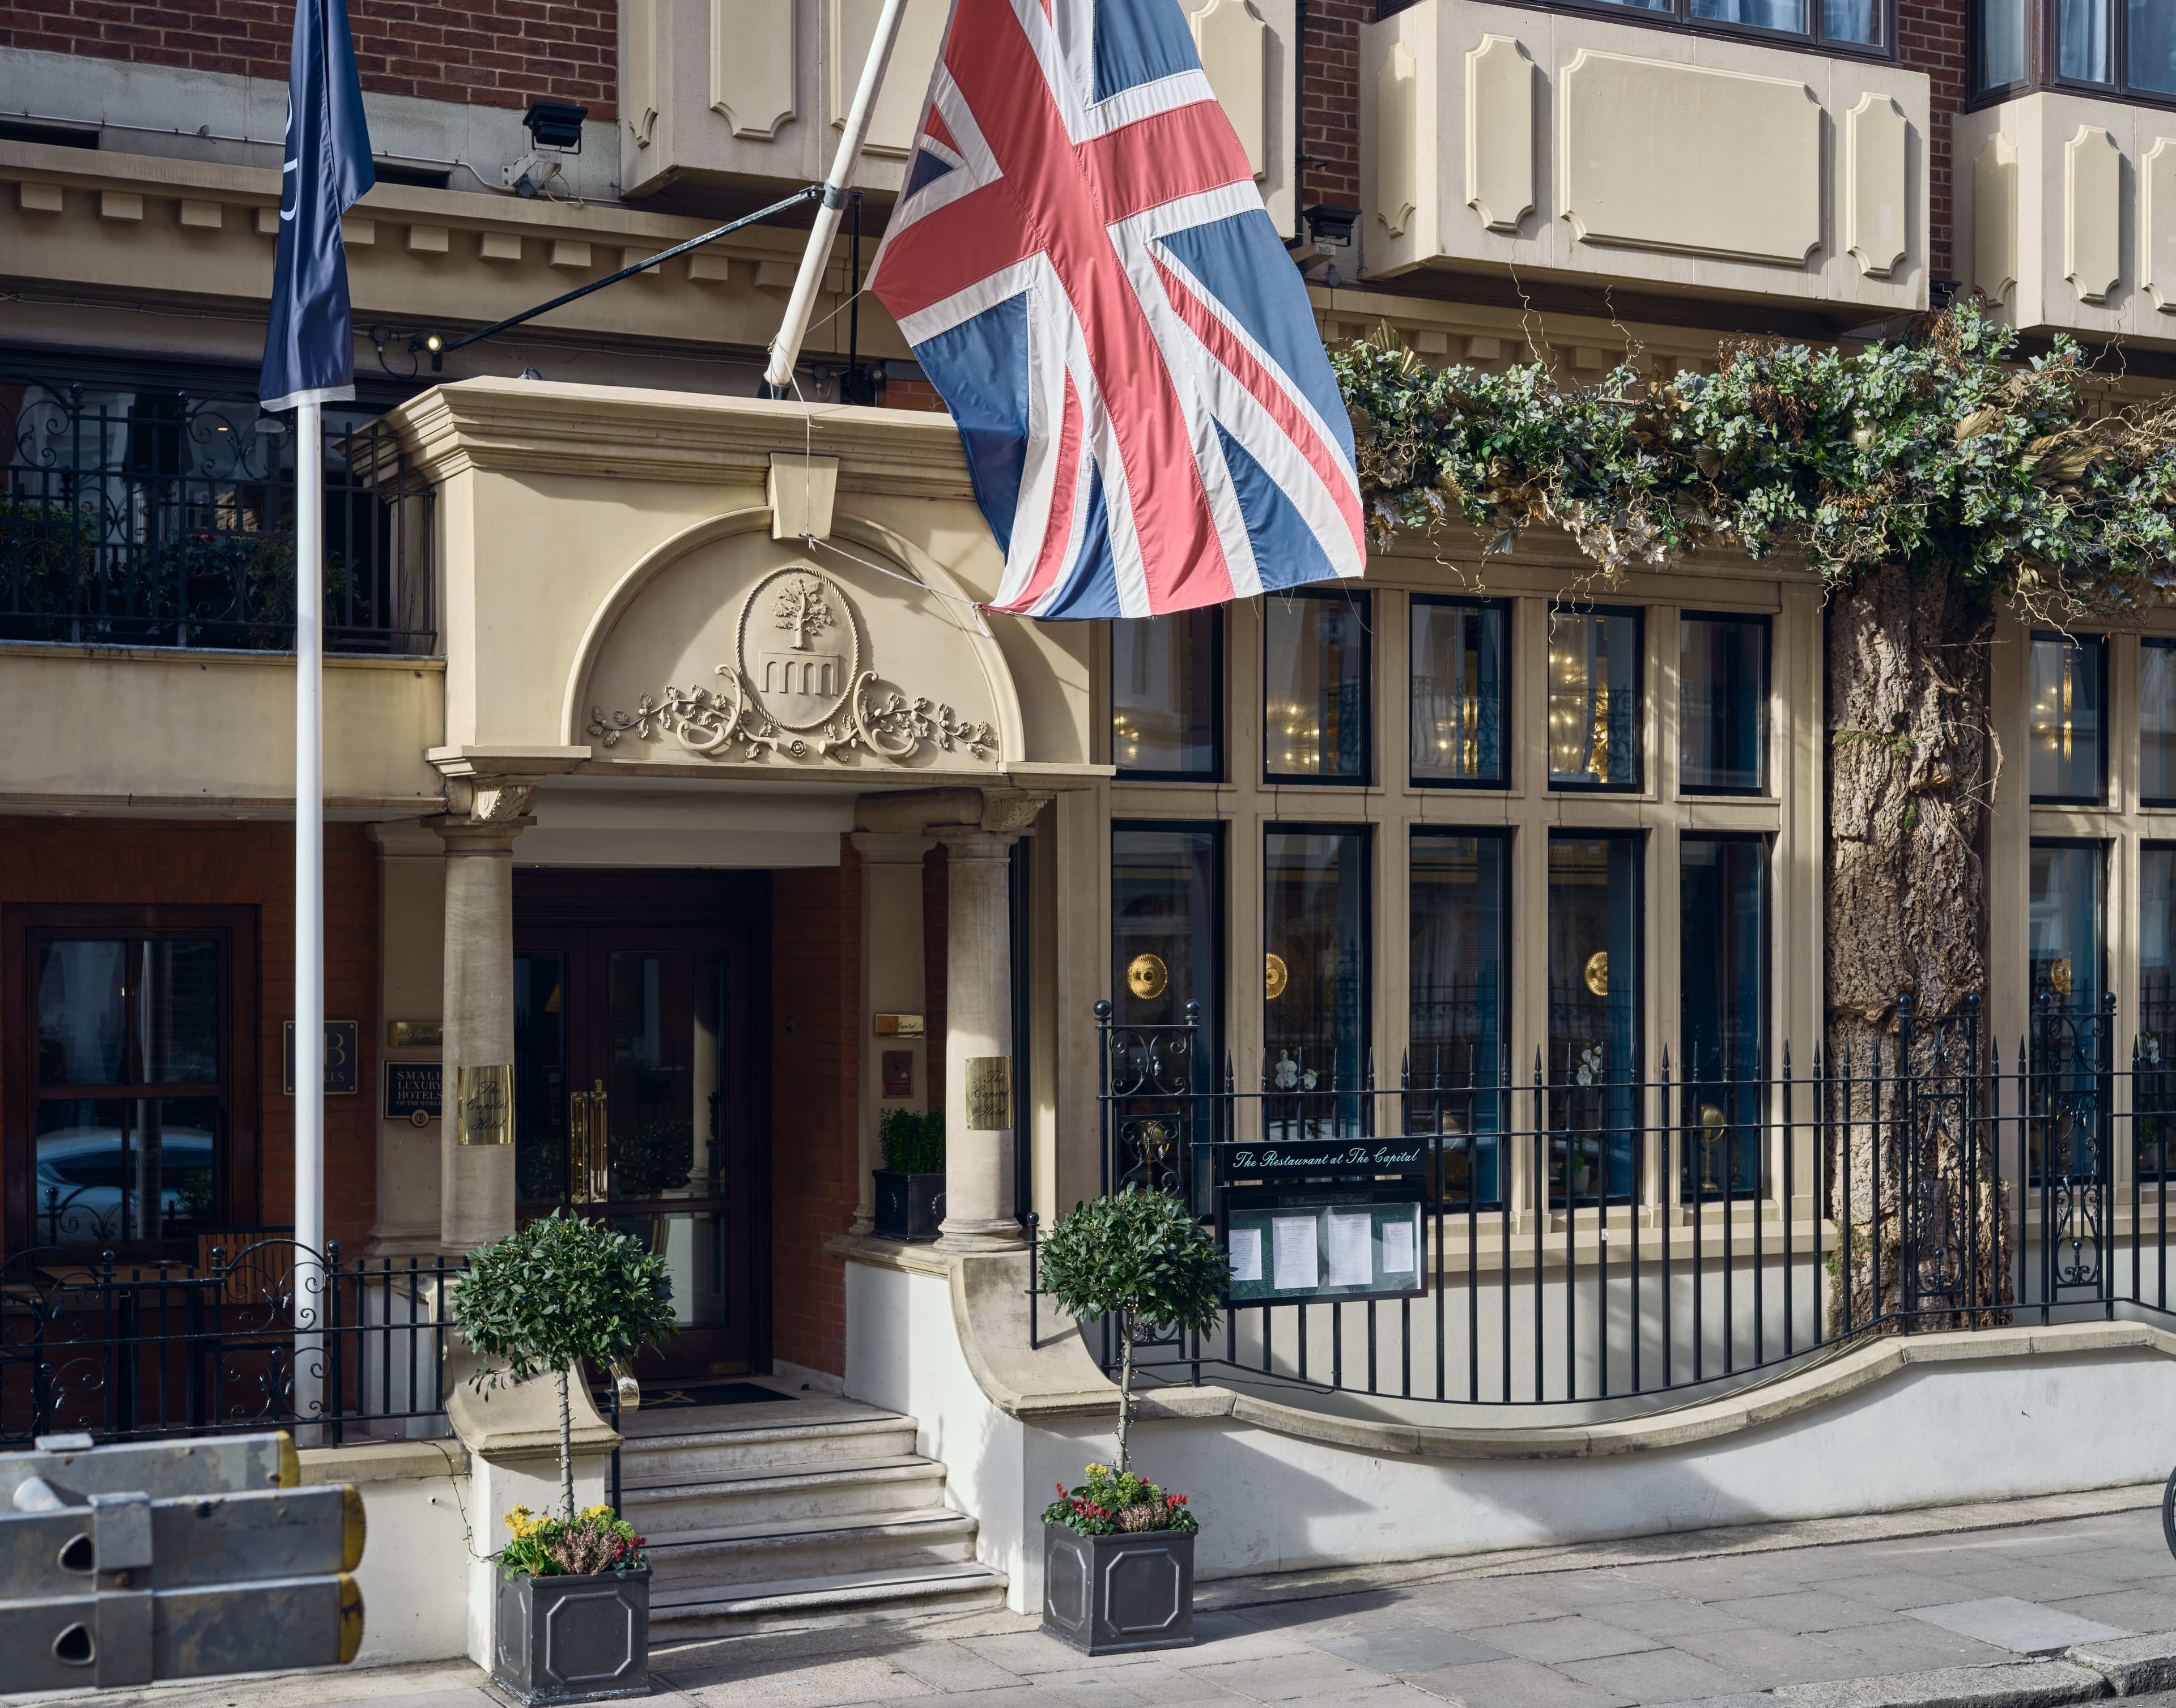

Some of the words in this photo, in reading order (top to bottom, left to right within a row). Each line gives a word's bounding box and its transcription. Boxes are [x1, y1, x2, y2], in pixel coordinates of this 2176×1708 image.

[984, 1070, 1004, 1083] The
[398, 1081, 443, 1089] LUXURY
[478, 1080, 500, 1094] The
[398, 1091, 443, 1100] HOTELS
[972, 1085, 1011, 1101] Capital
[466, 1097, 509, 1115] Capital
[978, 1104, 1009, 1117] Hotel
[471, 1117, 507, 1131] Hotel
[1232, 1152, 1257, 1168] The
[1259, 1151, 1329, 1167] Restaurant
[1330, 1154, 1344, 1164] at
[1346, 1148, 1370, 1164] The
[1372, 1147, 1420, 1168] Capital
